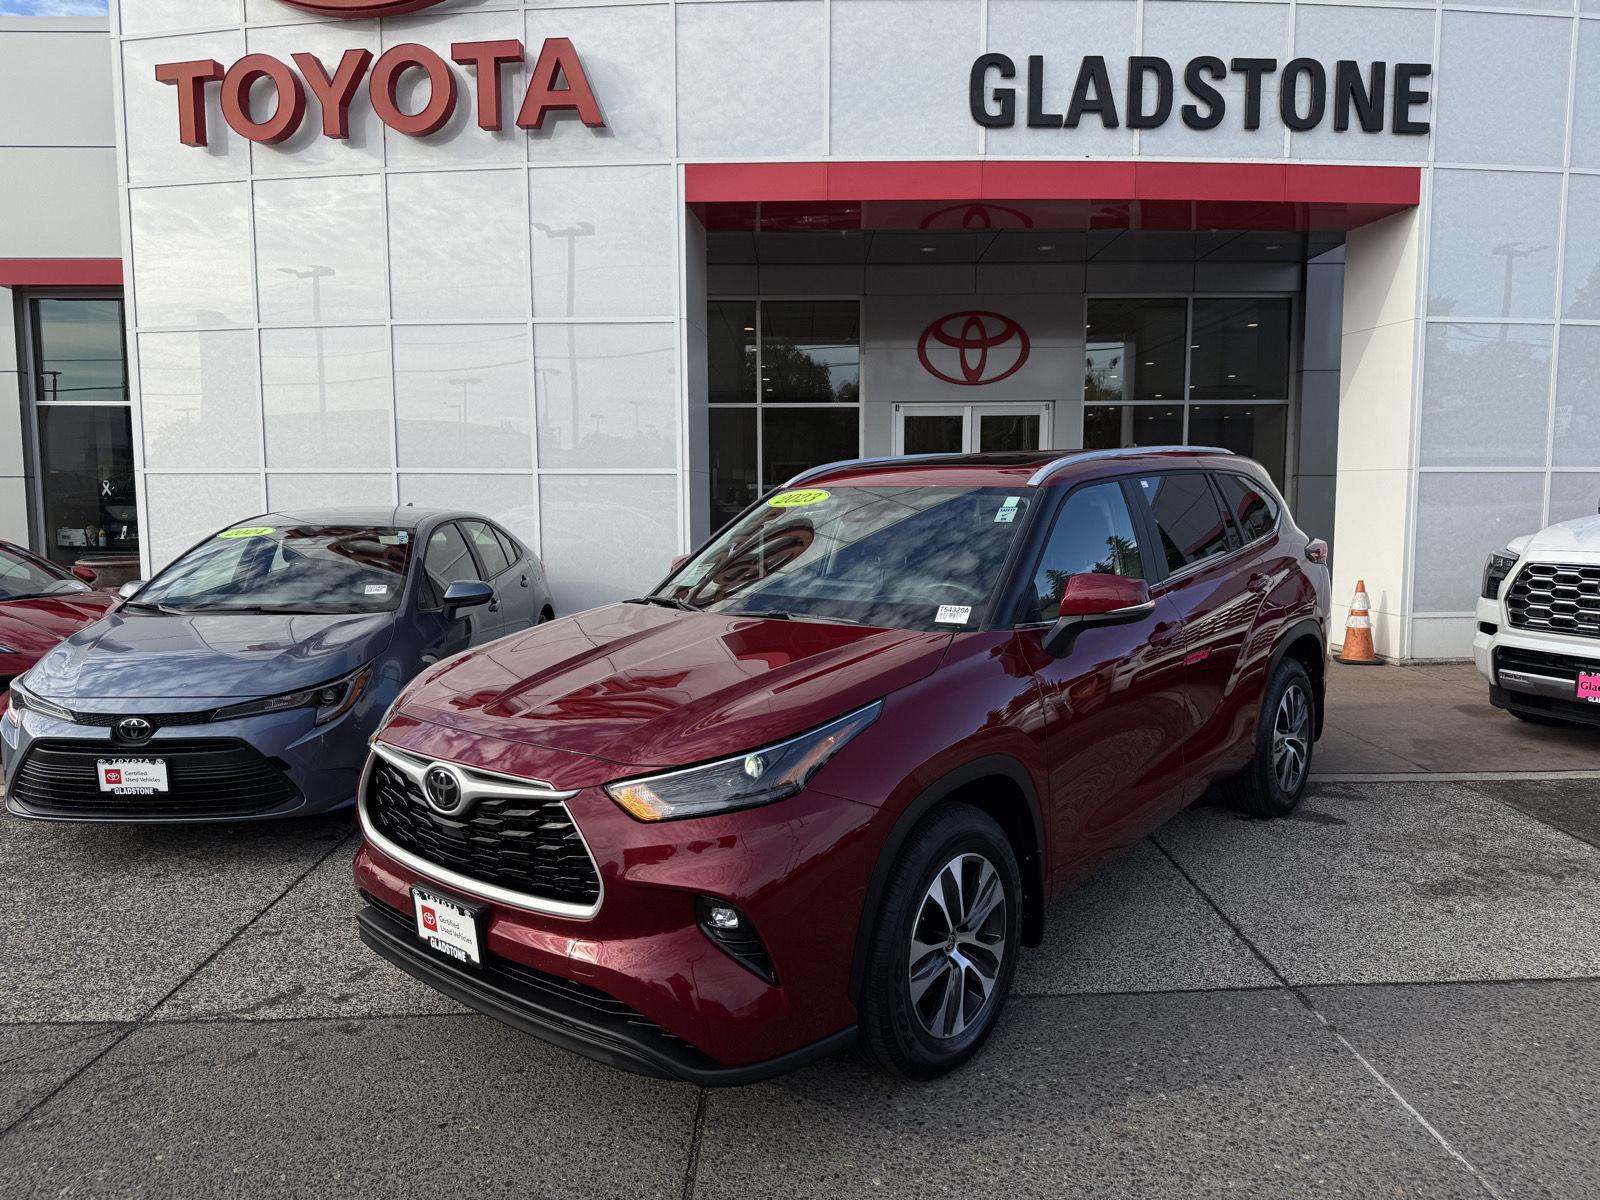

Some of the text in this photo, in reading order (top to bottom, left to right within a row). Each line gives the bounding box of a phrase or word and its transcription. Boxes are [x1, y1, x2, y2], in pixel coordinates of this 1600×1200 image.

[155, 37, 606, 147] TOYOTA
[969, 53, 1431, 135] GLADSTONE
[773, 492, 824, 505] 2023
[438, 915, 460, 929] Certified
[440, 925, 473, 945] Used Vehicles
[430, 938, 467, 963] GLADSTONE
